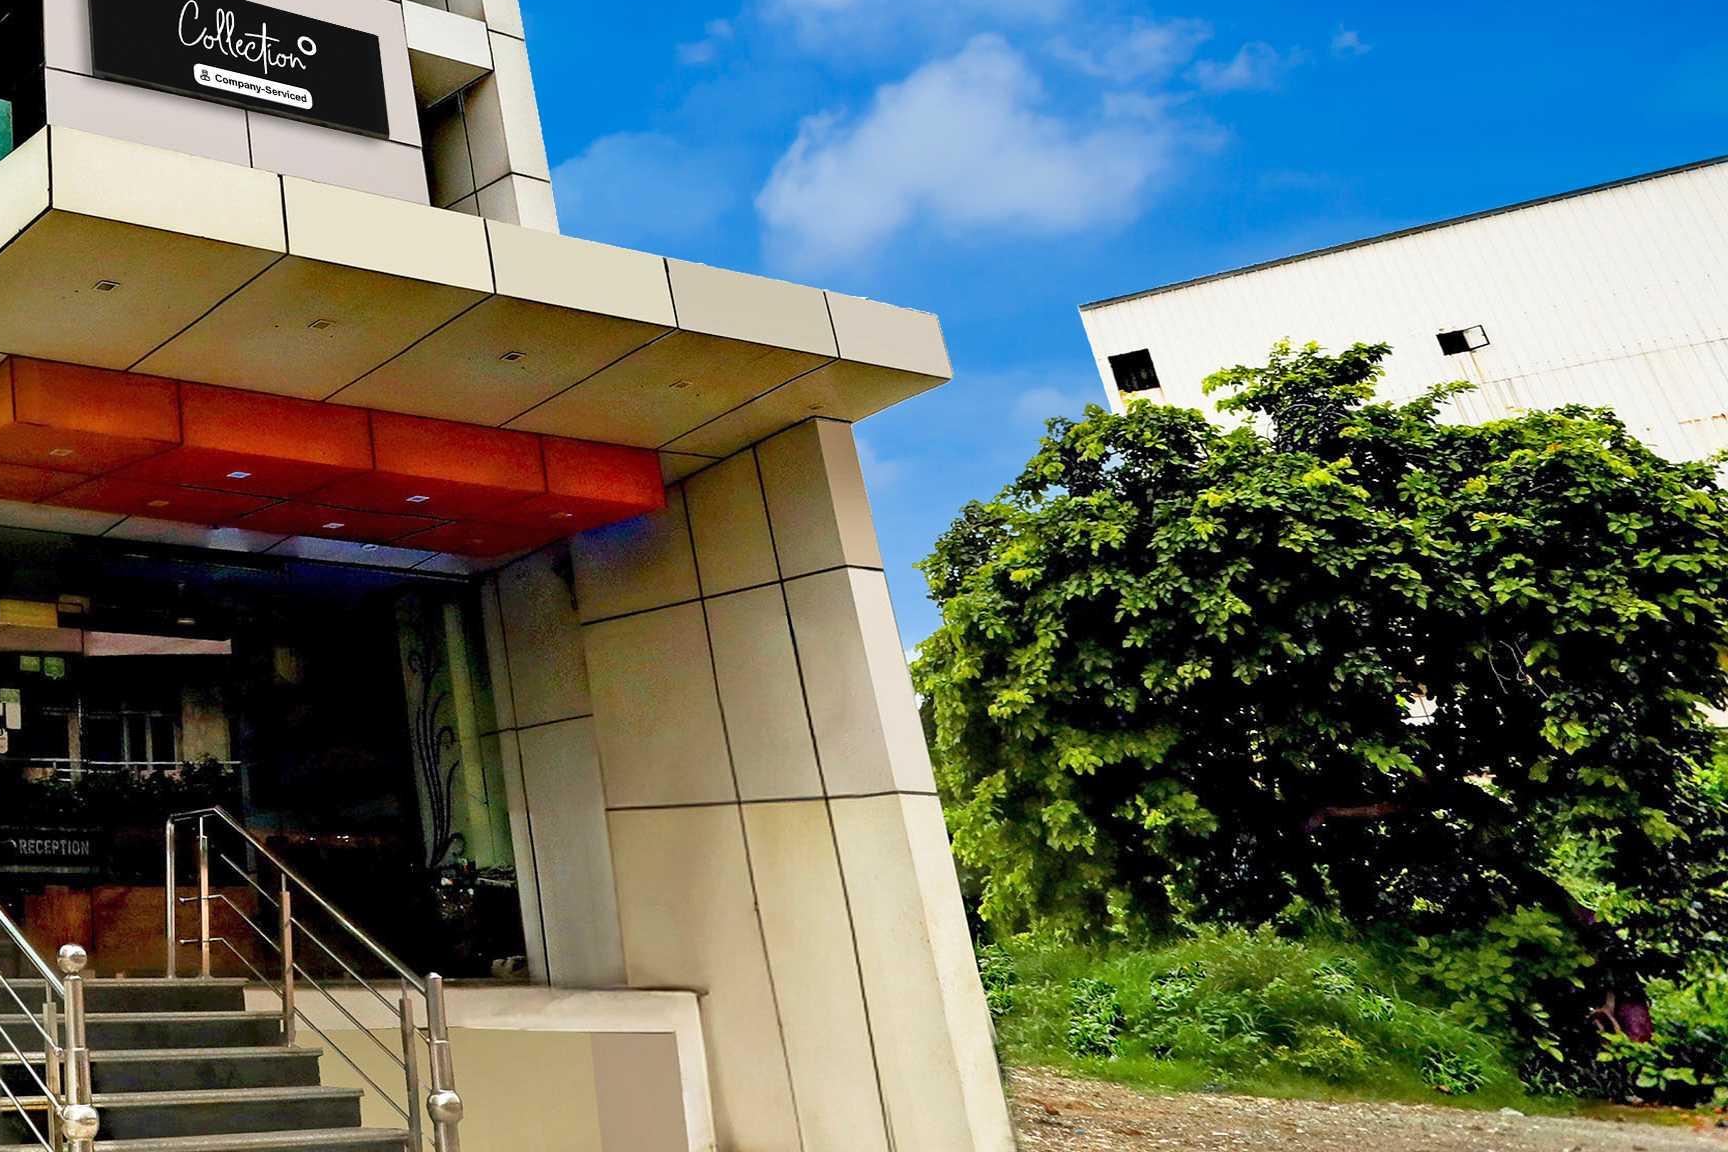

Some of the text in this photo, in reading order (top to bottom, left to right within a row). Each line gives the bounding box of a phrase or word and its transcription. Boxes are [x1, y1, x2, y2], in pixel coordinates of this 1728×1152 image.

[178, 0, 306, 75] Collection
[214, 74, 308, 103] Company-Serviced
[18, 839, 90, 856] RECEPTION
